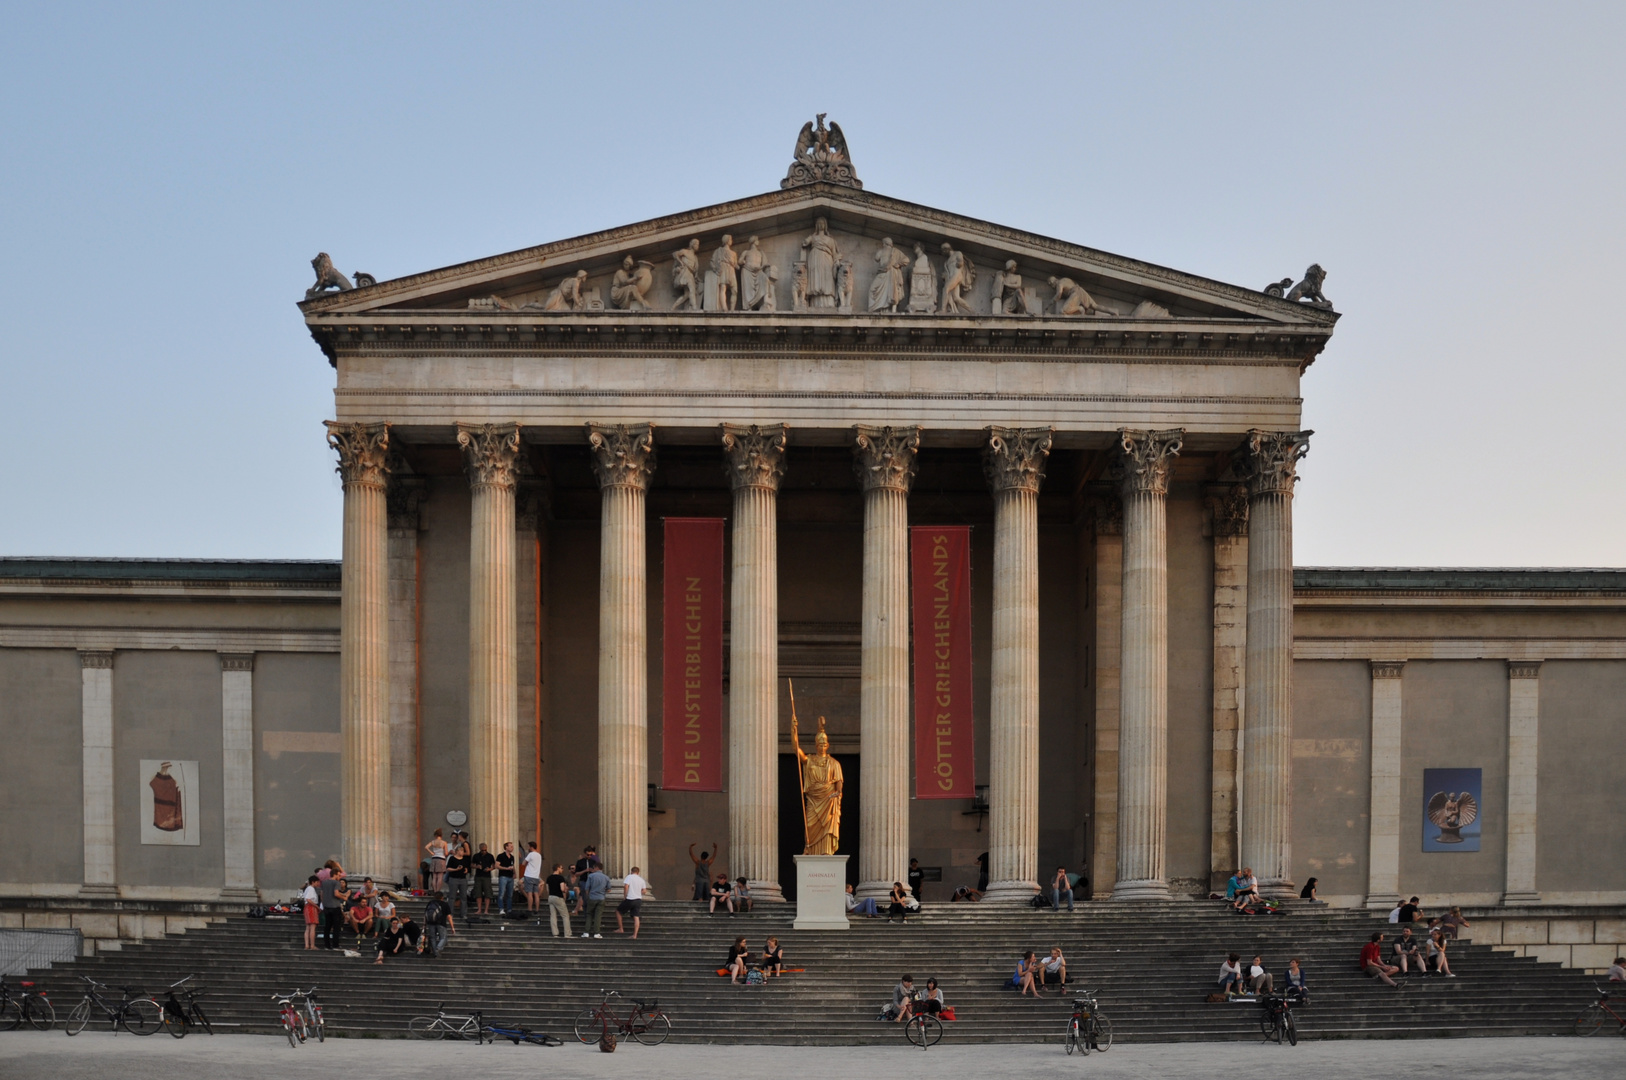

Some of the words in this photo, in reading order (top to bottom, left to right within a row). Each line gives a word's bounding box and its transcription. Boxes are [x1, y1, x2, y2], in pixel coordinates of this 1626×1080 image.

[685, 577, 702, 745] UNSTERBLICHEN
[933, 535, 951, 708] GRIECHENLANDS
[684, 752, 701, 783] DIE
[933, 712, 953, 791] GÖTTER
